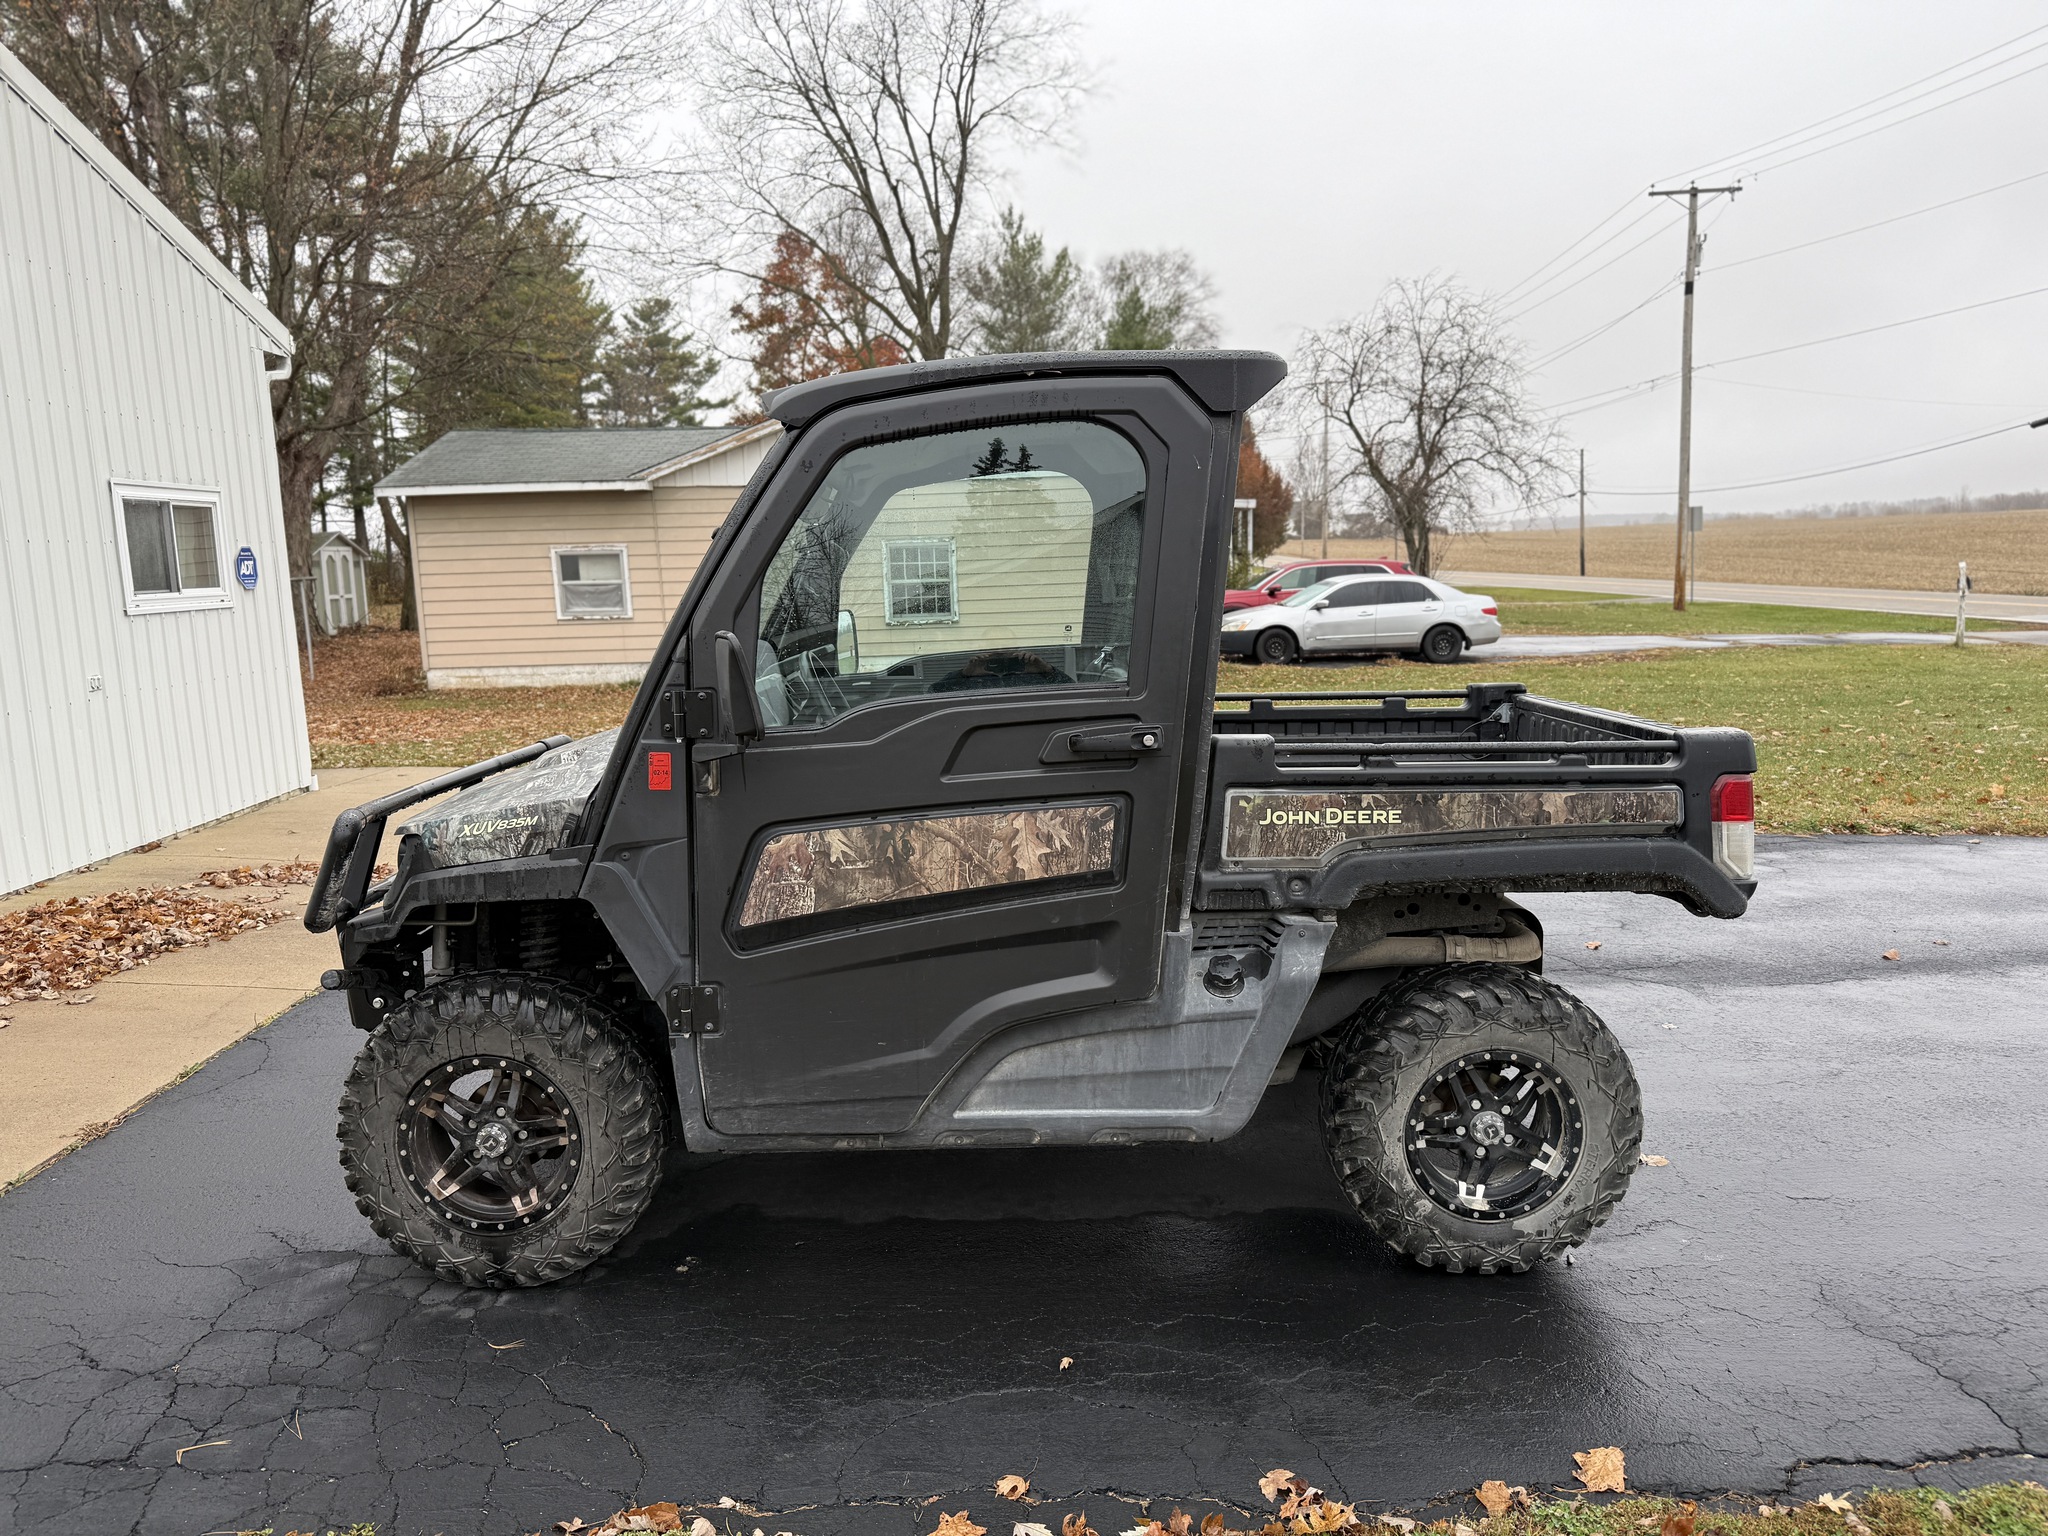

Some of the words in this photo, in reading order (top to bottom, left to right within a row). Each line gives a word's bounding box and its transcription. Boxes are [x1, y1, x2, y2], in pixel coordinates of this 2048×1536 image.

[240, 560, 253, 575] ADT
[458, 815, 539, 838] XUV835M
[1259, 808, 1320, 826] JOHN
[1326, 807, 1402, 825] DEERE
[526, 1054, 587, 1111] ERRABITE
[1546, 1152, 1599, 1220] TERRABTE
